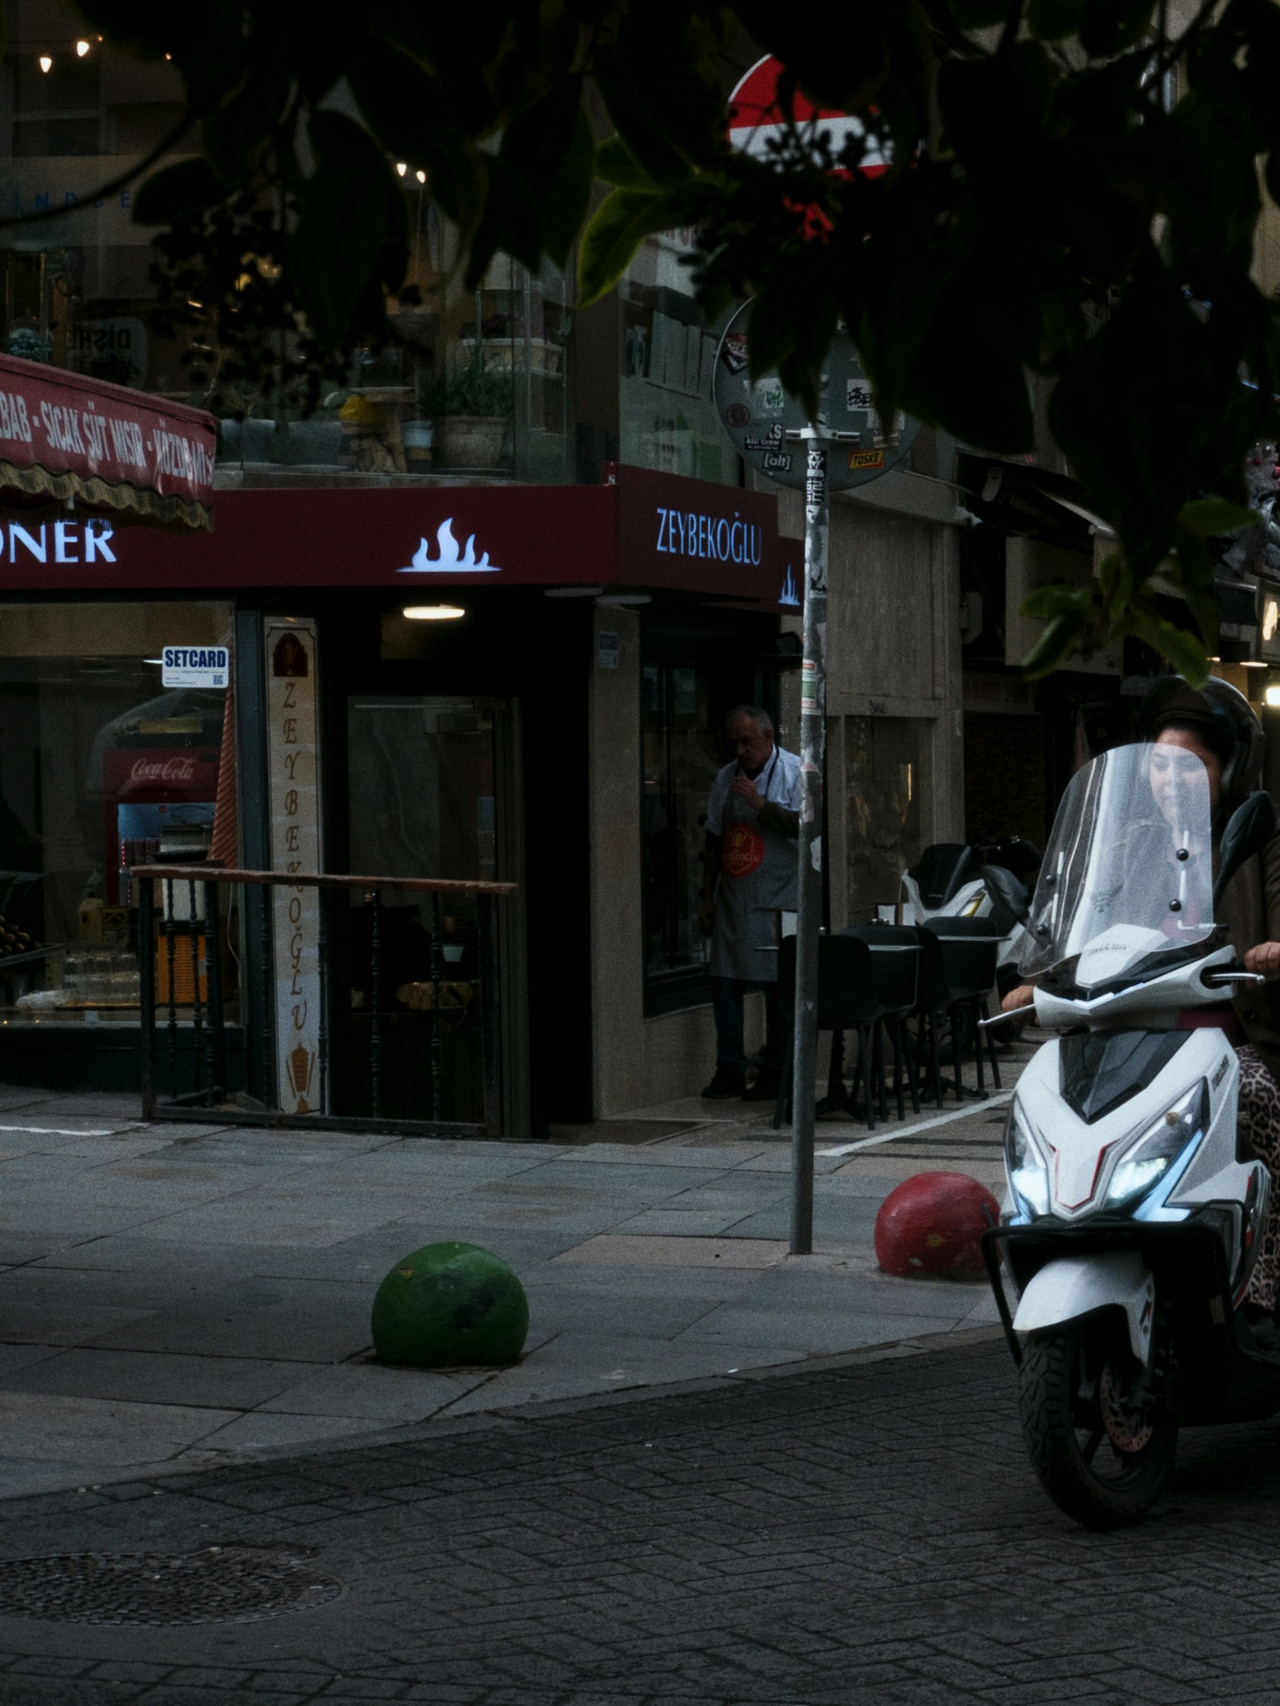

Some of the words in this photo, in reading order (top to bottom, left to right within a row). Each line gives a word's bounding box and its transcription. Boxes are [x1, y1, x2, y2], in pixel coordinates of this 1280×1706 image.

[853, 452, 881, 466] TOSKE
[0, 517, 118, 563] NER
[656, 508, 762, 566] ZEYBEKOĞLU
[165, 650, 226, 668] SETCARD
